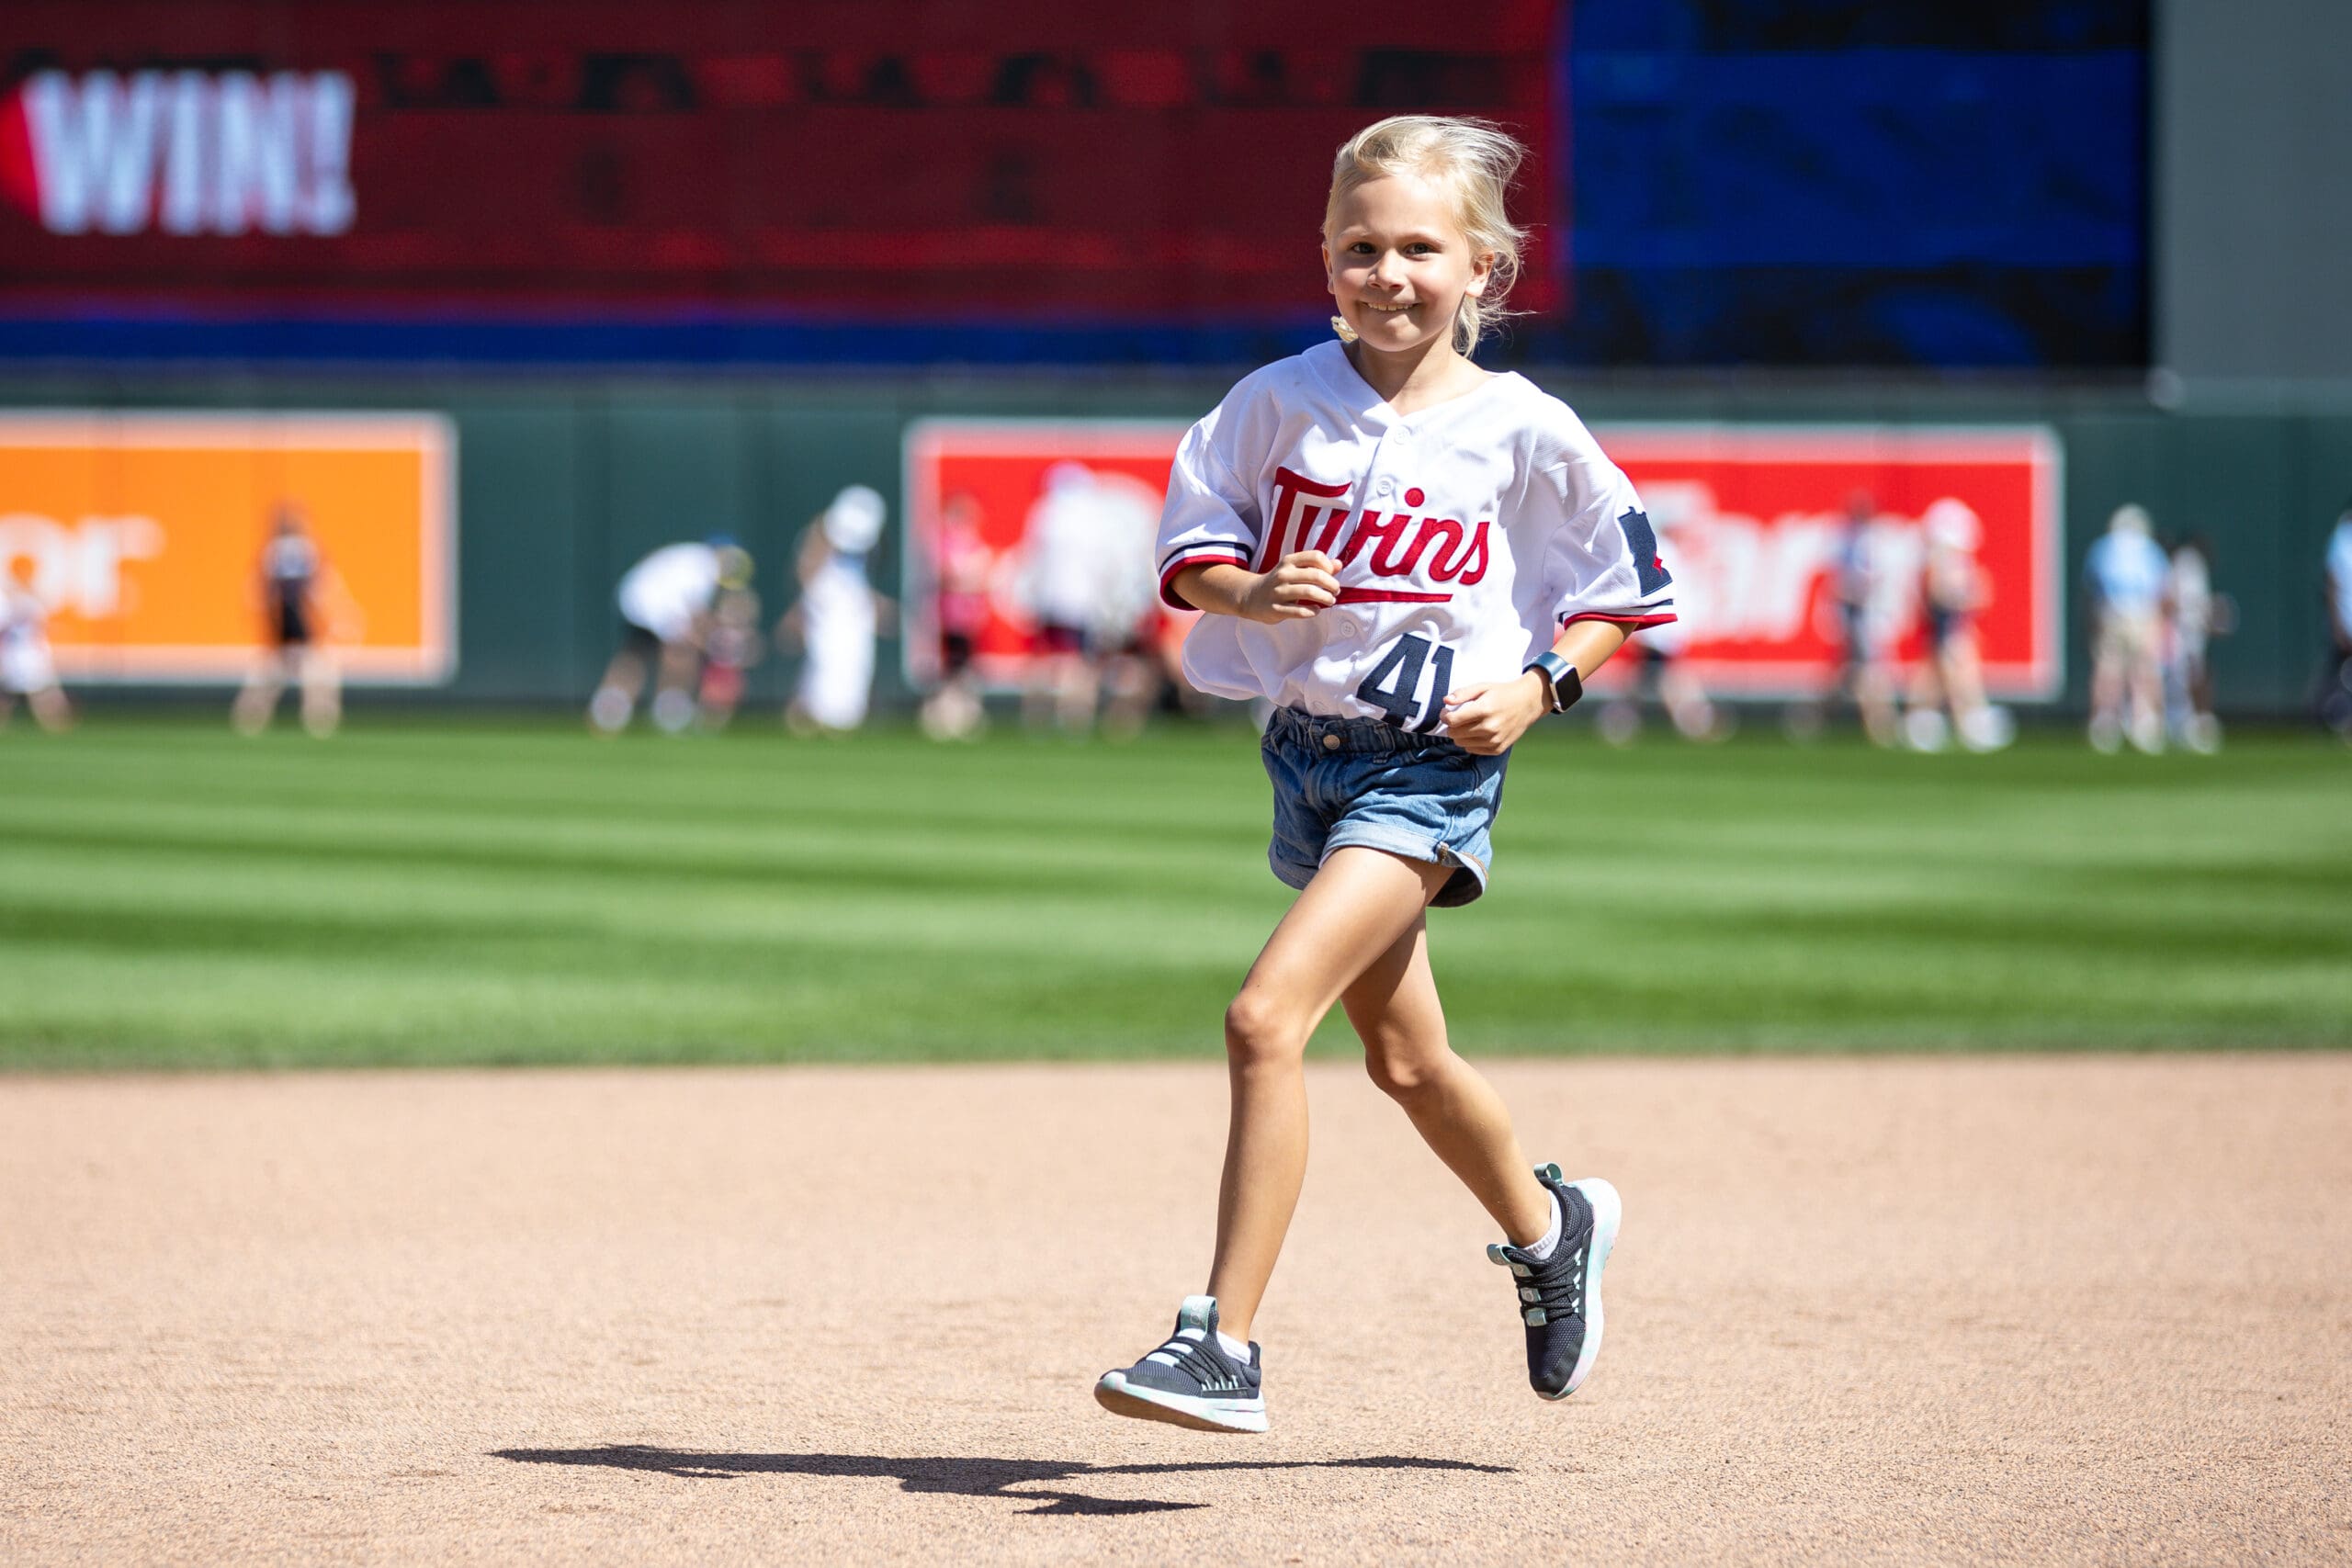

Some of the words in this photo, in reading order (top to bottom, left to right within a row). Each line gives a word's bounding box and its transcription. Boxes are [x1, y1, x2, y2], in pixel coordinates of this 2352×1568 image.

[26, 71, 355, 236] WIN!
[1256, 466, 1491, 586] Twins
[1356, 632, 1454, 733] 41
